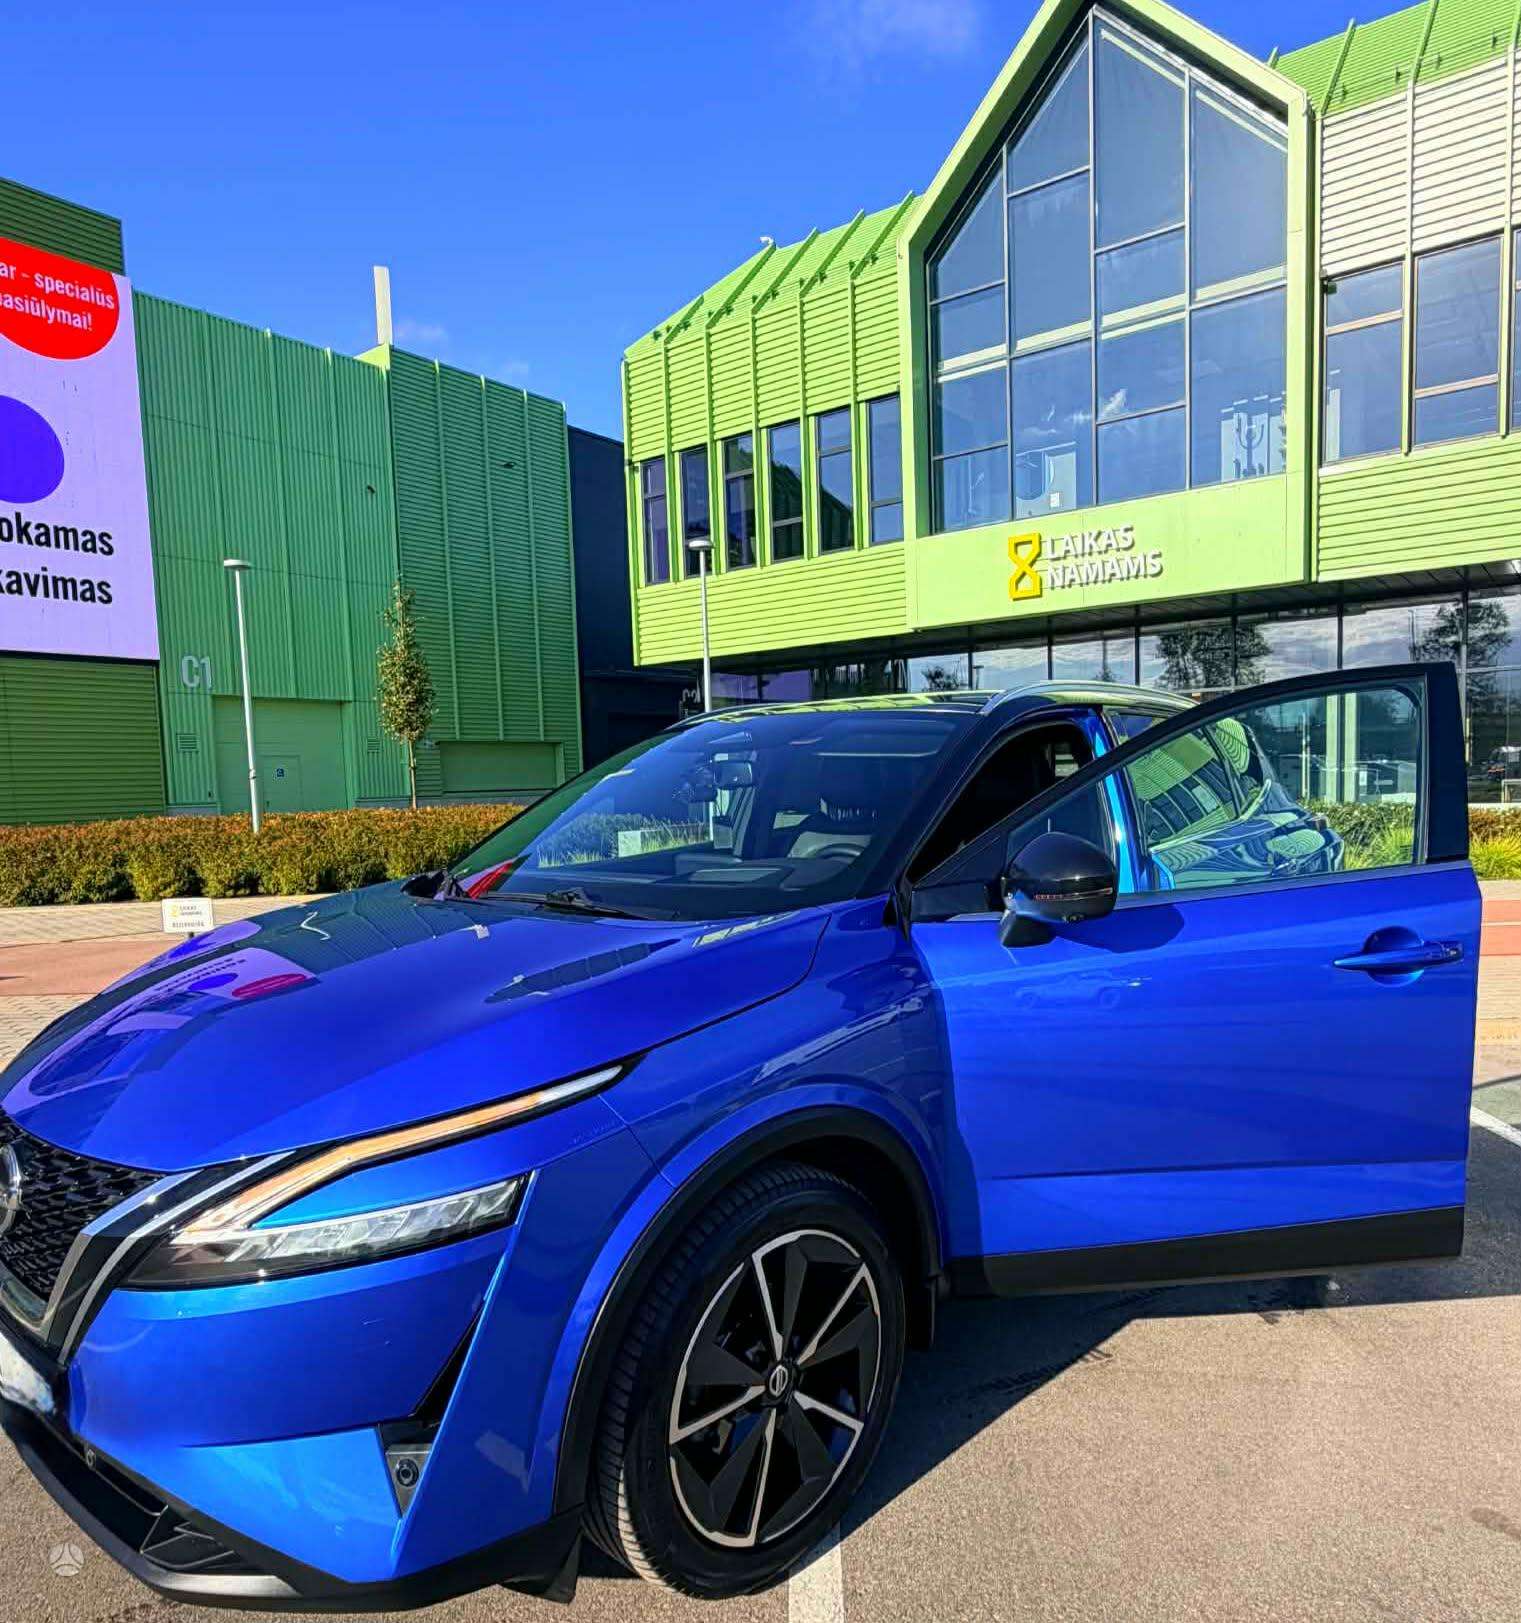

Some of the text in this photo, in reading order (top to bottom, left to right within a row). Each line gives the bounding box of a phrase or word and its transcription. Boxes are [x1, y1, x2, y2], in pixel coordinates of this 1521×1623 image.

[34, 272, 115, 310] specialūs
[0, 292, 93, 332] asiūlymai!
[1046, 524, 1135, 561] LAIKAS
[1047, 551, 1163, 590] NAMAMS
[181, 654, 213, 690] C1
